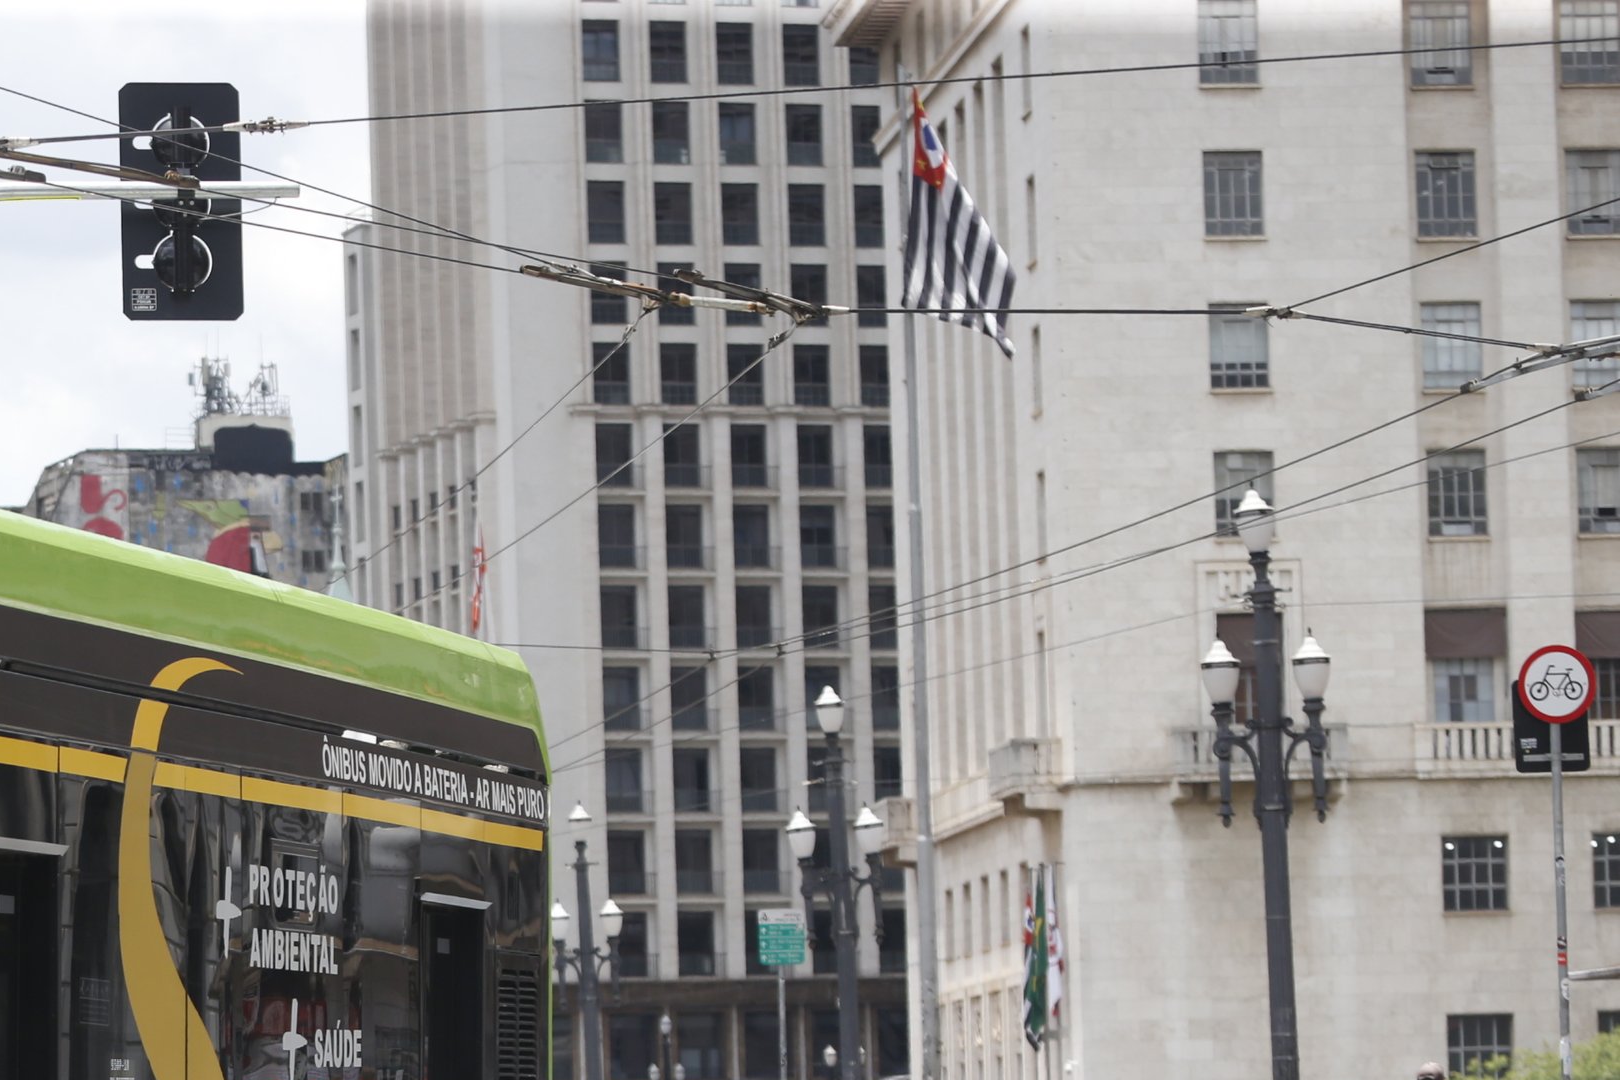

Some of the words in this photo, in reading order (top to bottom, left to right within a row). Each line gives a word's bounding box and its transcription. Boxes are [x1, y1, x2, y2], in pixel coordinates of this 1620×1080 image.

[322, 734, 366, 783] ÔNIBUS
[369, 753, 412, 792] MOVIDO
[414, 763, 423, 794] A
[424, 765, 469, 805] BATERIA
[475, 777, 490, 810] AR
[491, 781, 516, 814] MAIS
[518, 786, 544, 819] PURO
[249, 864, 339, 922] PROTEÇÃO
[249, 927, 339, 975] AMBIENTAL
[314, 1019, 362, 1068] SAÚDE
